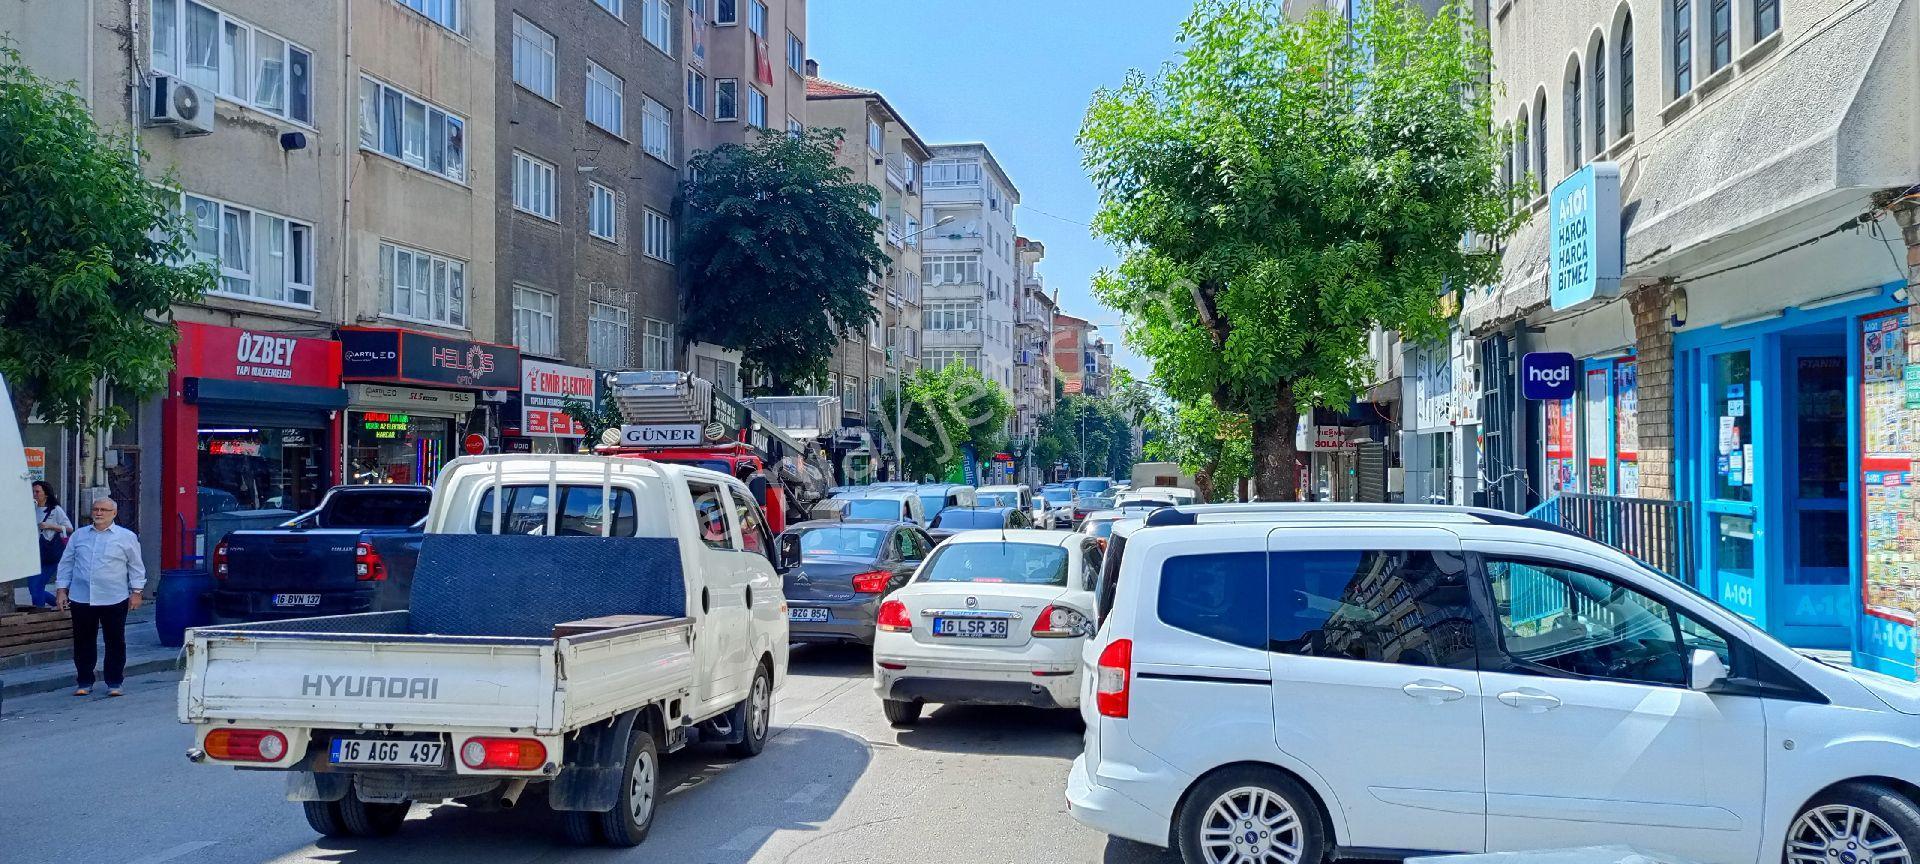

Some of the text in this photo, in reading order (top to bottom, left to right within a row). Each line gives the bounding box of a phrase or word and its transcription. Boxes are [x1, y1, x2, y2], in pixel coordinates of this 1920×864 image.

[1558, 216, 1588, 246] HARCA
[1558, 240, 1588, 271] HARCA
[1558, 261, 1588, 292] BİTMEZ
[237, 331, 297, 366] ÖZBEY
[236, 365, 250, 376] YAPI
[1529, 366, 1570, 382] hadi
[540, 370, 560, 394] EMİR
[562, 375, 593, 397] ELEKTRİK
[626, 428, 695, 442] GÜNER
[276, 594, 320, 604] 16 BVN 137
[792, 608, 827, 619] BZG 854
[941, 620, 1006, 633] 16 LSR 36
[302, 674, 439, 700] HYUNDAI
[343, 743, 360, 761] 16
[367, 744, 399, 762] AGG
[409, 743, 441, 764] 497
